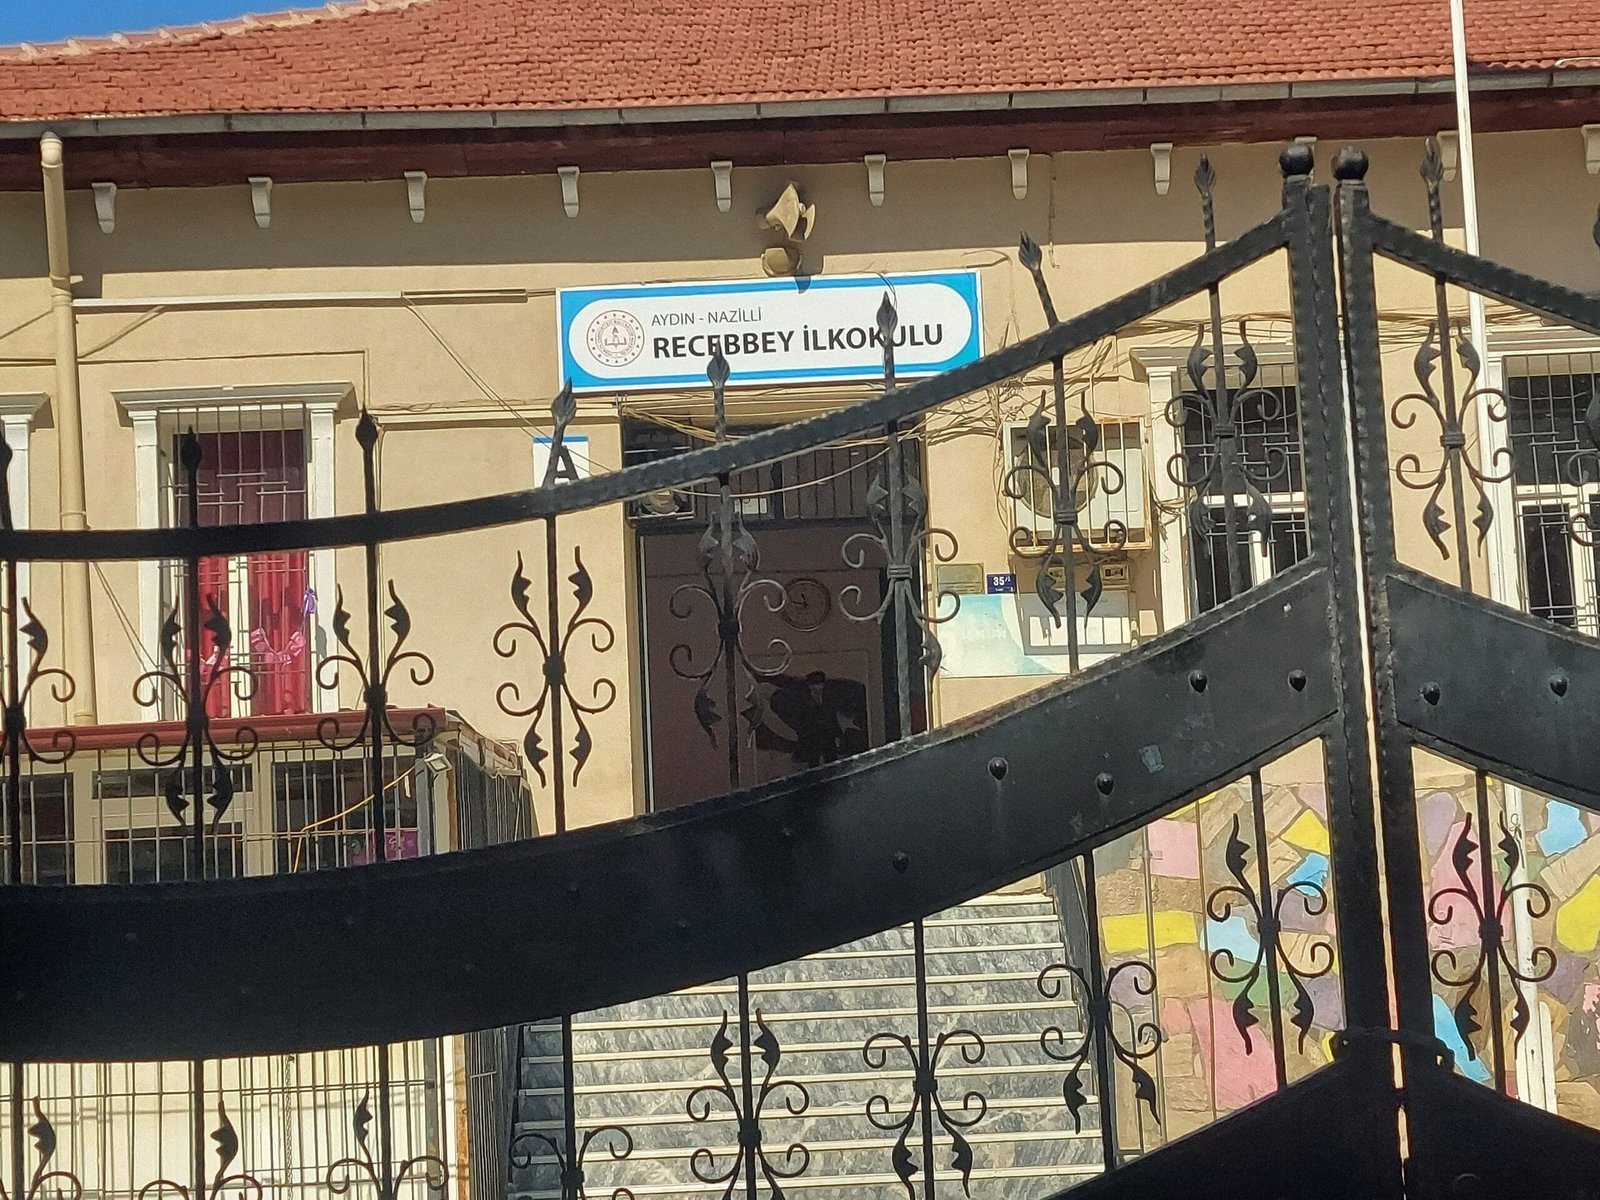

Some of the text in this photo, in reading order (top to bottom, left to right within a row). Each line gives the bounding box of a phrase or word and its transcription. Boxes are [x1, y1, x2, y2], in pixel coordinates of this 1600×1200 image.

[651, 312, 695, 327] AYDIN
[707, 306, 762, 324] NAZİLLİ
[653, 329, 796, 359] RECEBBEY
[802, 323, 943, 352] İLKOKULU
